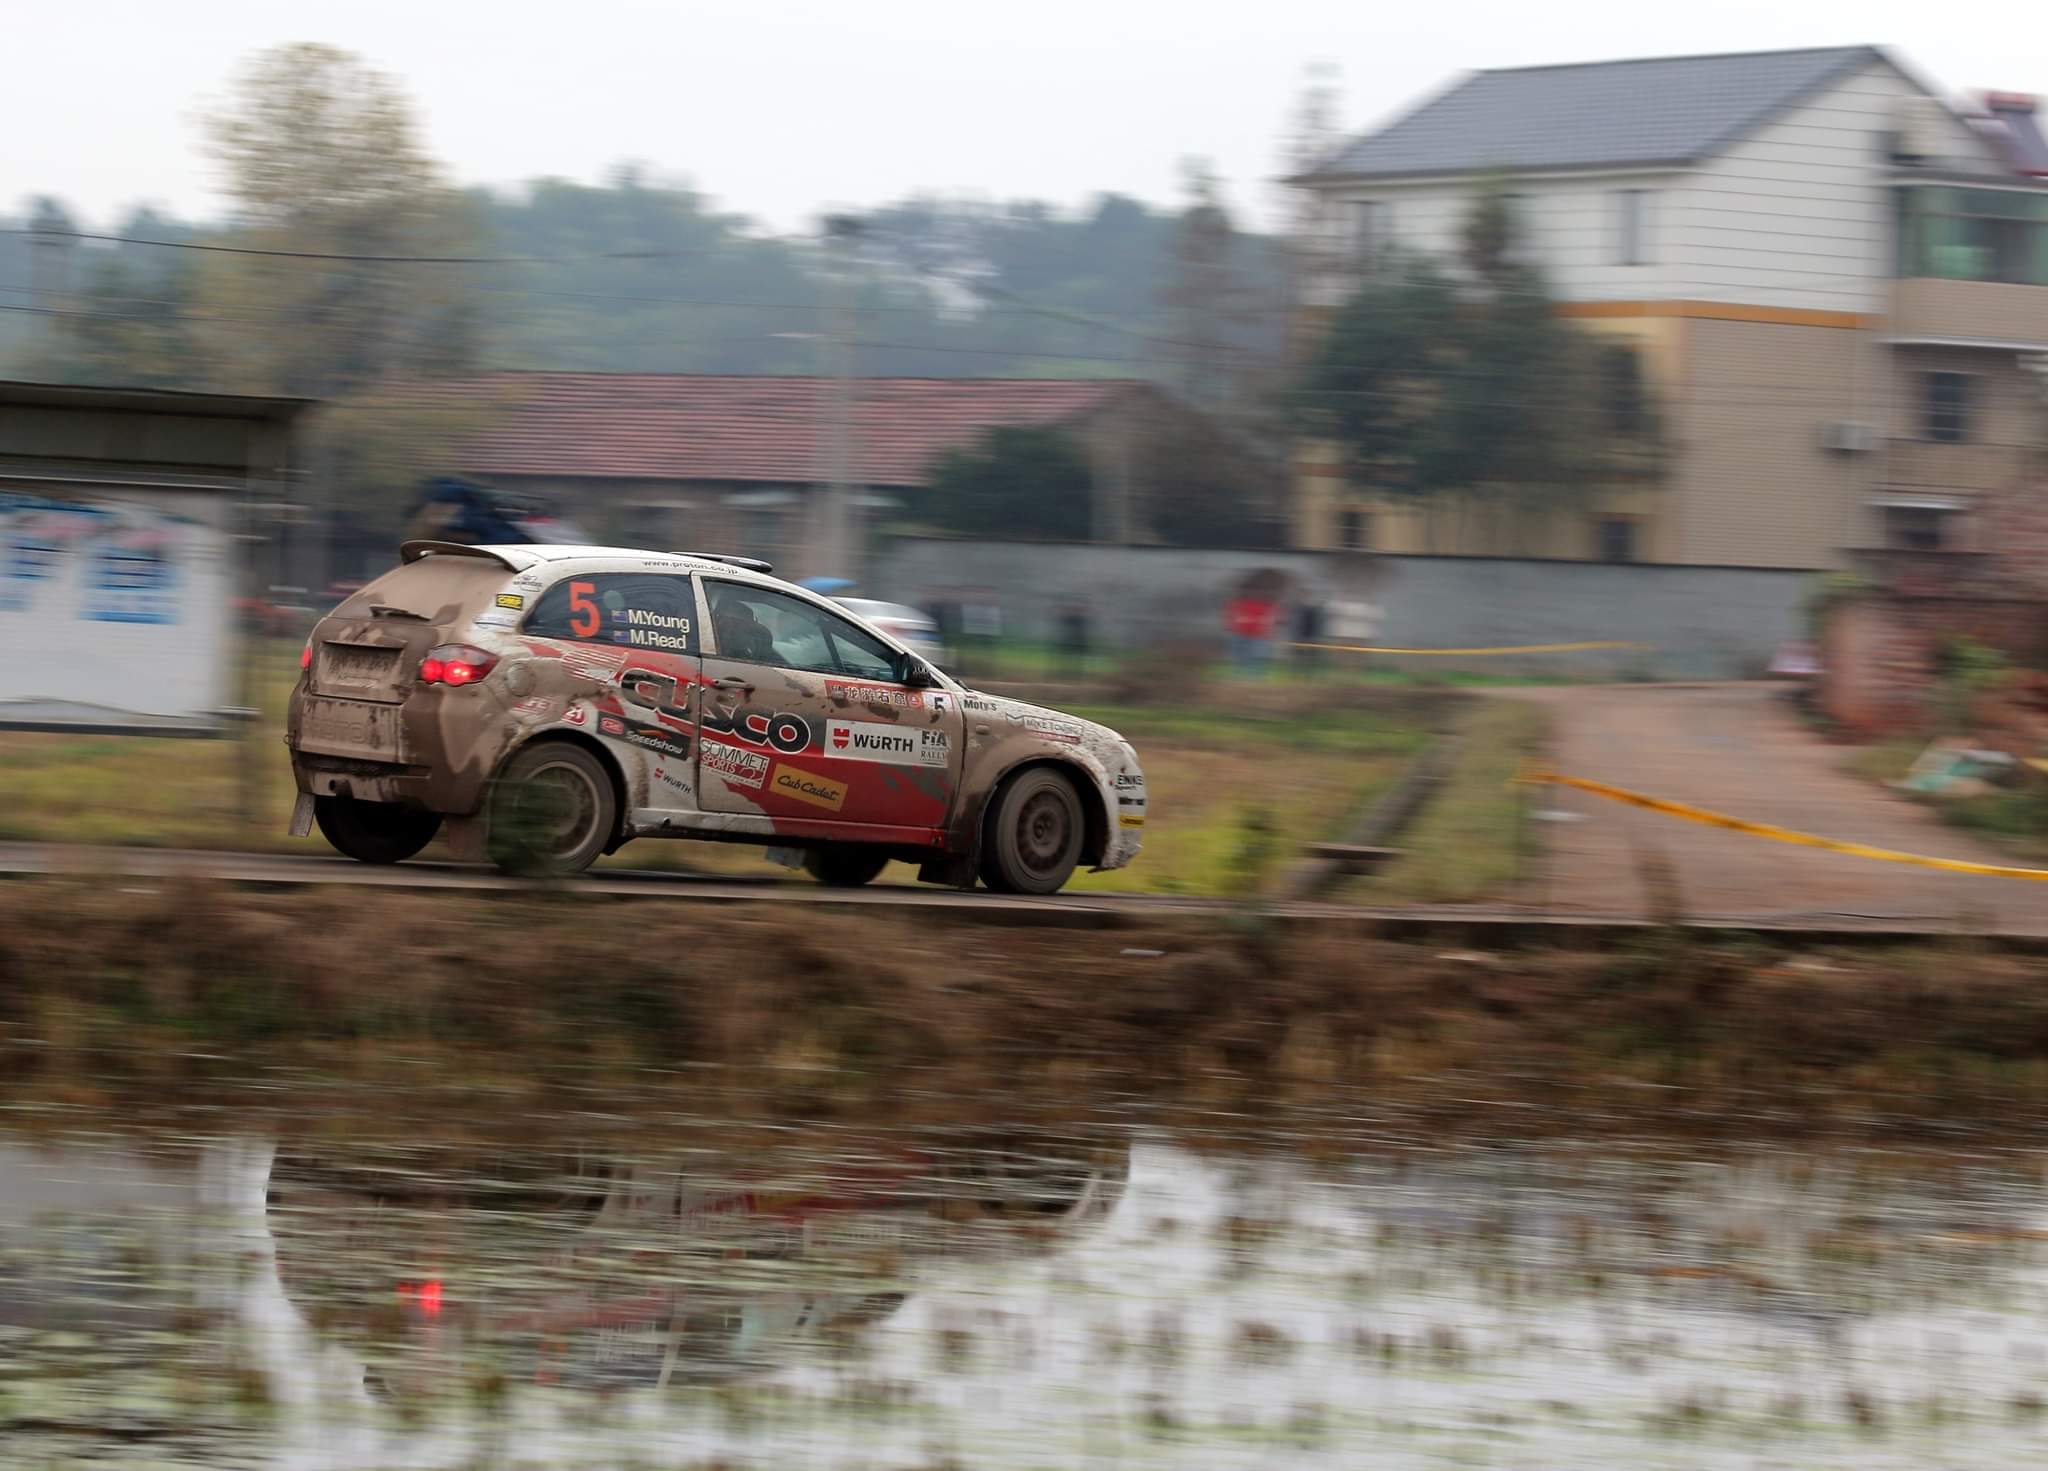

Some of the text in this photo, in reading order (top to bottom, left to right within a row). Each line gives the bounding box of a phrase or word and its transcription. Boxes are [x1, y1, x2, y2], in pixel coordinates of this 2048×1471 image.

[568, 580, 602, 637] 5
[628, 609, 690, 633] M.Young
[629, 629, 687, 649] M.Read
[625, 730, 684, 754] Speedshow
[701, 753, 737, 774] SPORTS
[777, 775, 801, 789] Cub
[801, 782, 840, 800] Cadet
